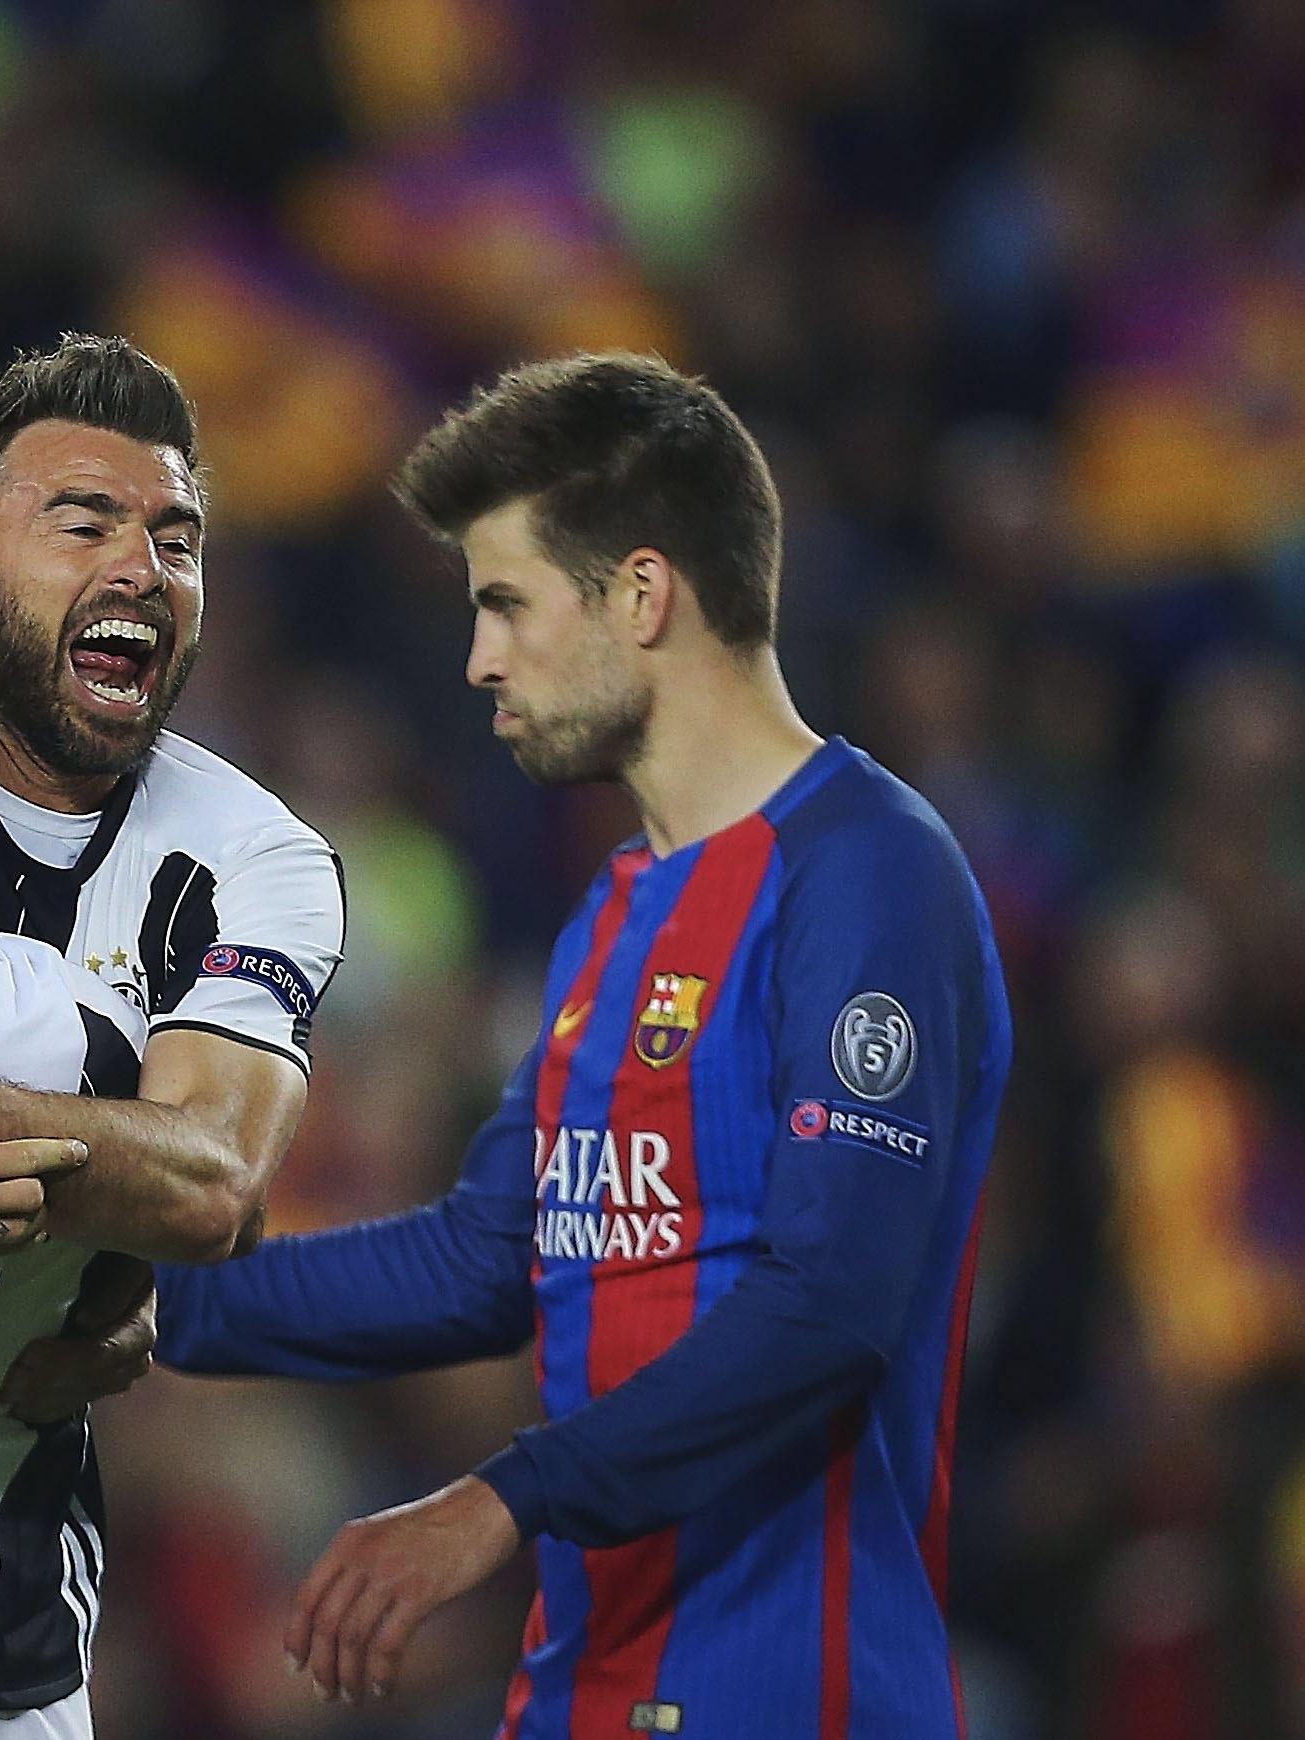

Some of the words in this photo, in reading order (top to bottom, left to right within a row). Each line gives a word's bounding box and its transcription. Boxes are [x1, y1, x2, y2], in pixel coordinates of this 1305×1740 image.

[862, 1043, 885, 1072] 5
[829, 1111, 930, 1157] RESPECT
[534, 1126, 682, 1208] ATAR
